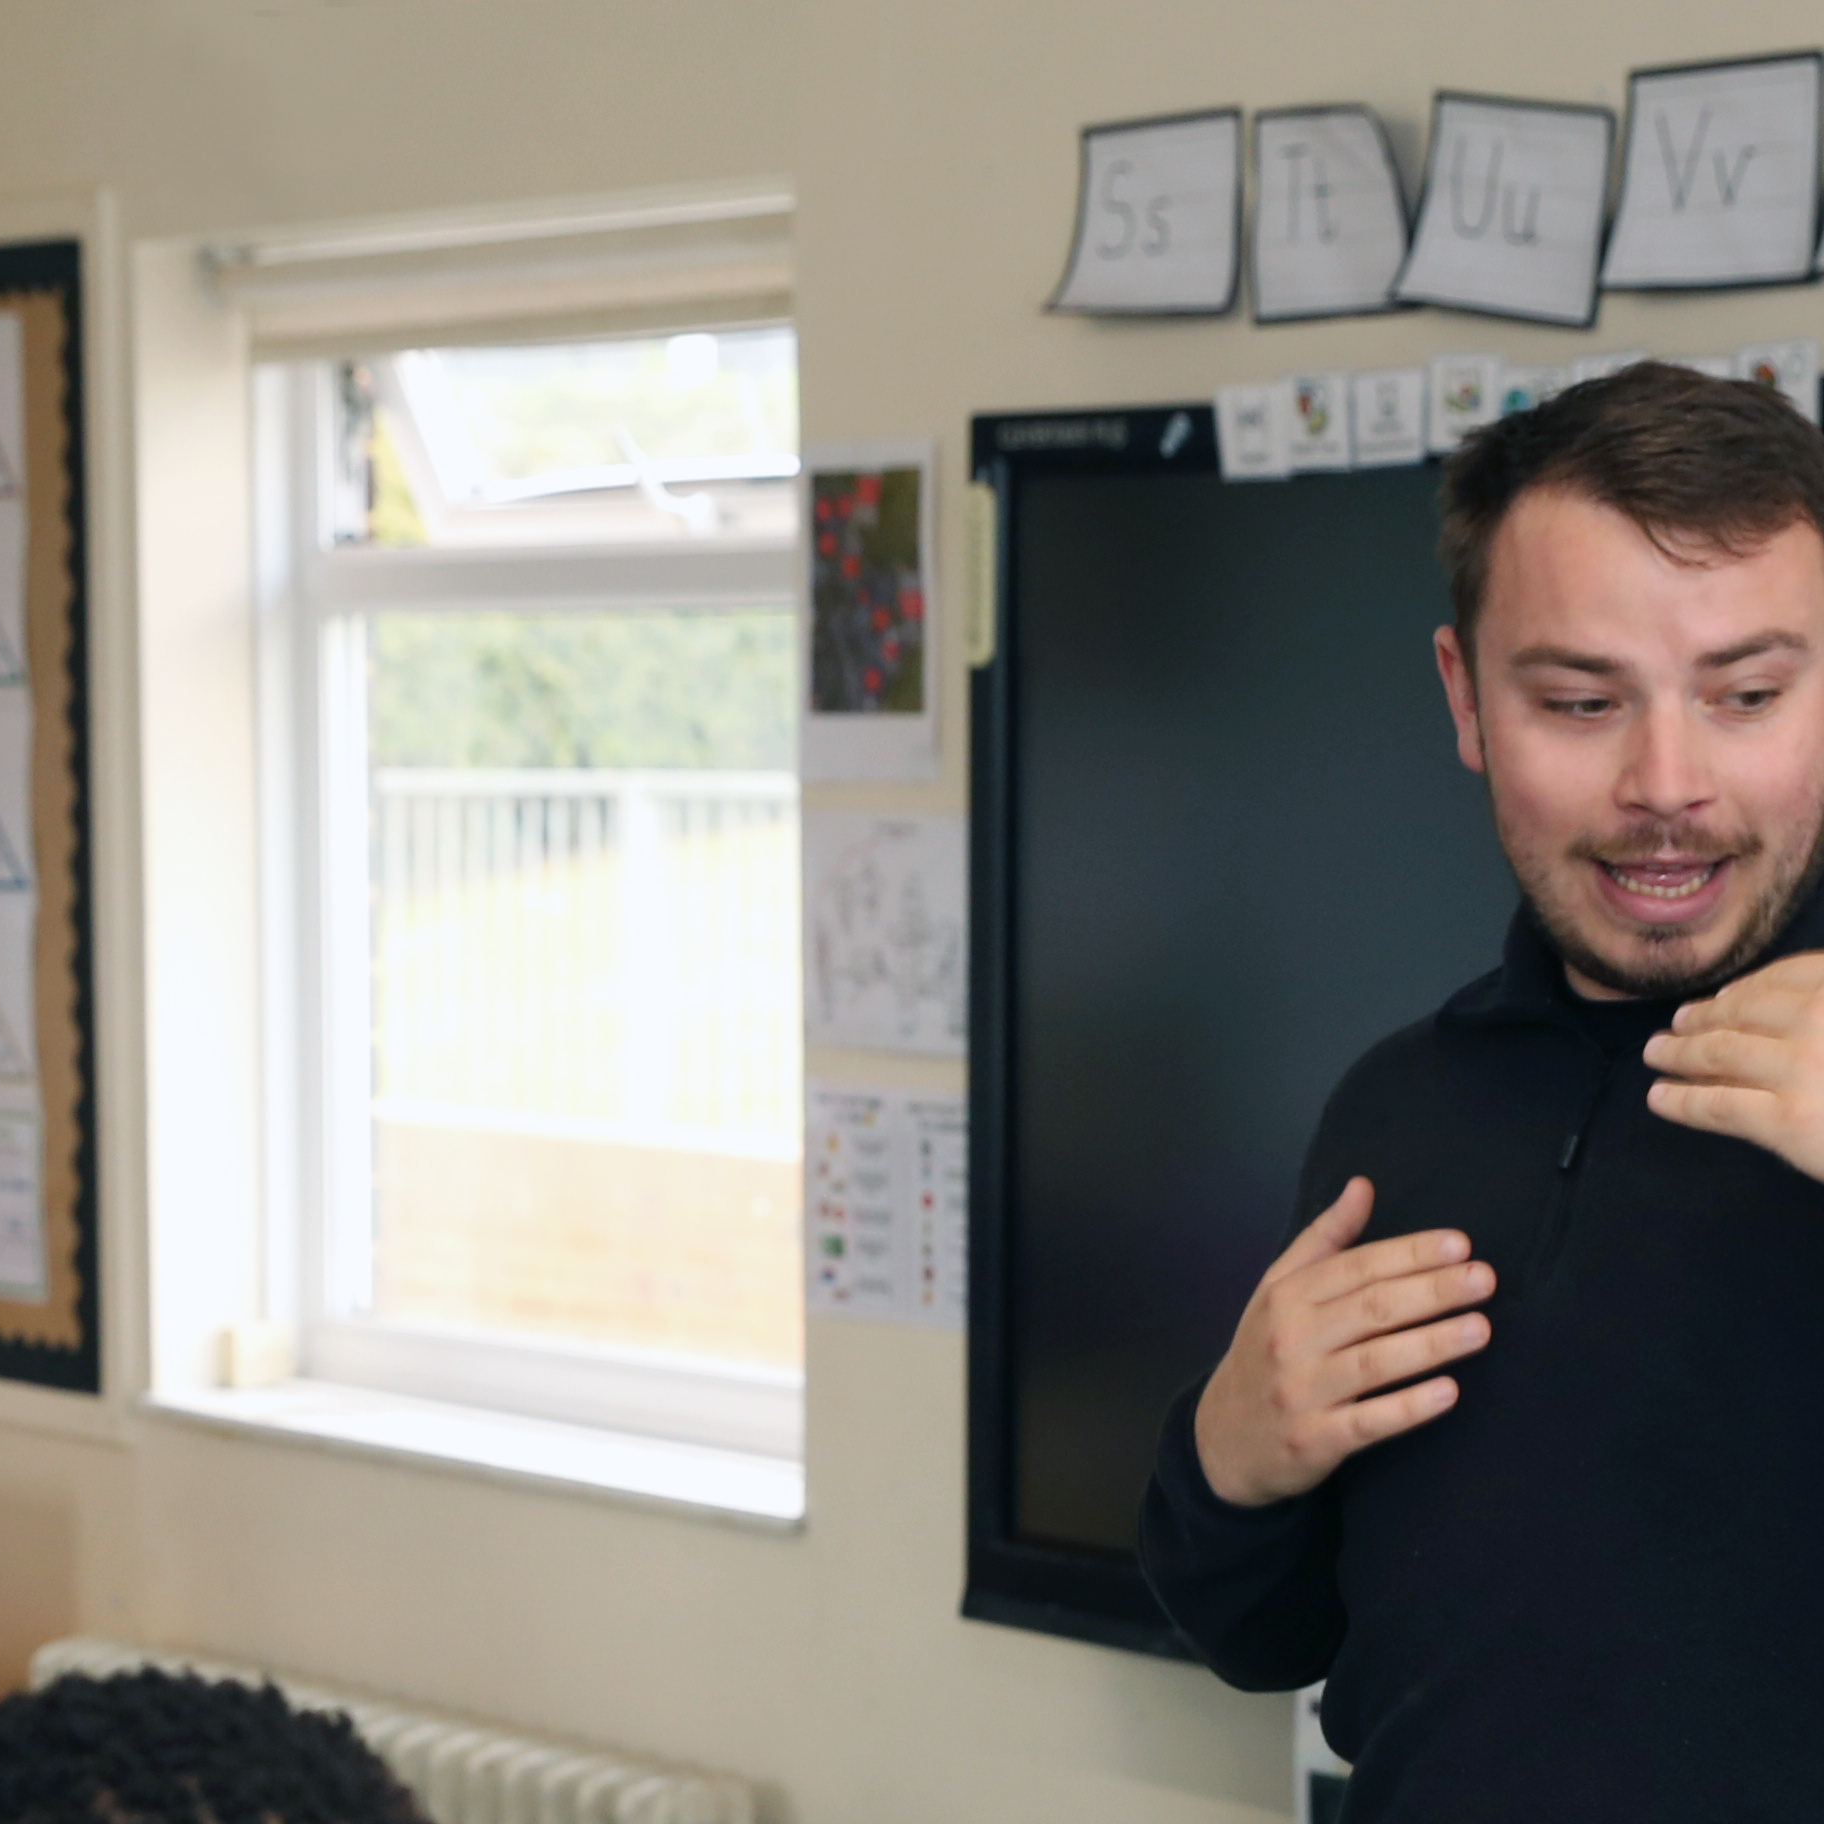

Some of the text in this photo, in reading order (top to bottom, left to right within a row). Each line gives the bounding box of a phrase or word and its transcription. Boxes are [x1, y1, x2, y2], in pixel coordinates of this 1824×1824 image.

[1095, 159, 1173, 261] Ss
[1280, 141, 1341, 246] Tt
[1449, 131, 1543, 246] Uu
[1654, 106, 1758, 213] Vv
